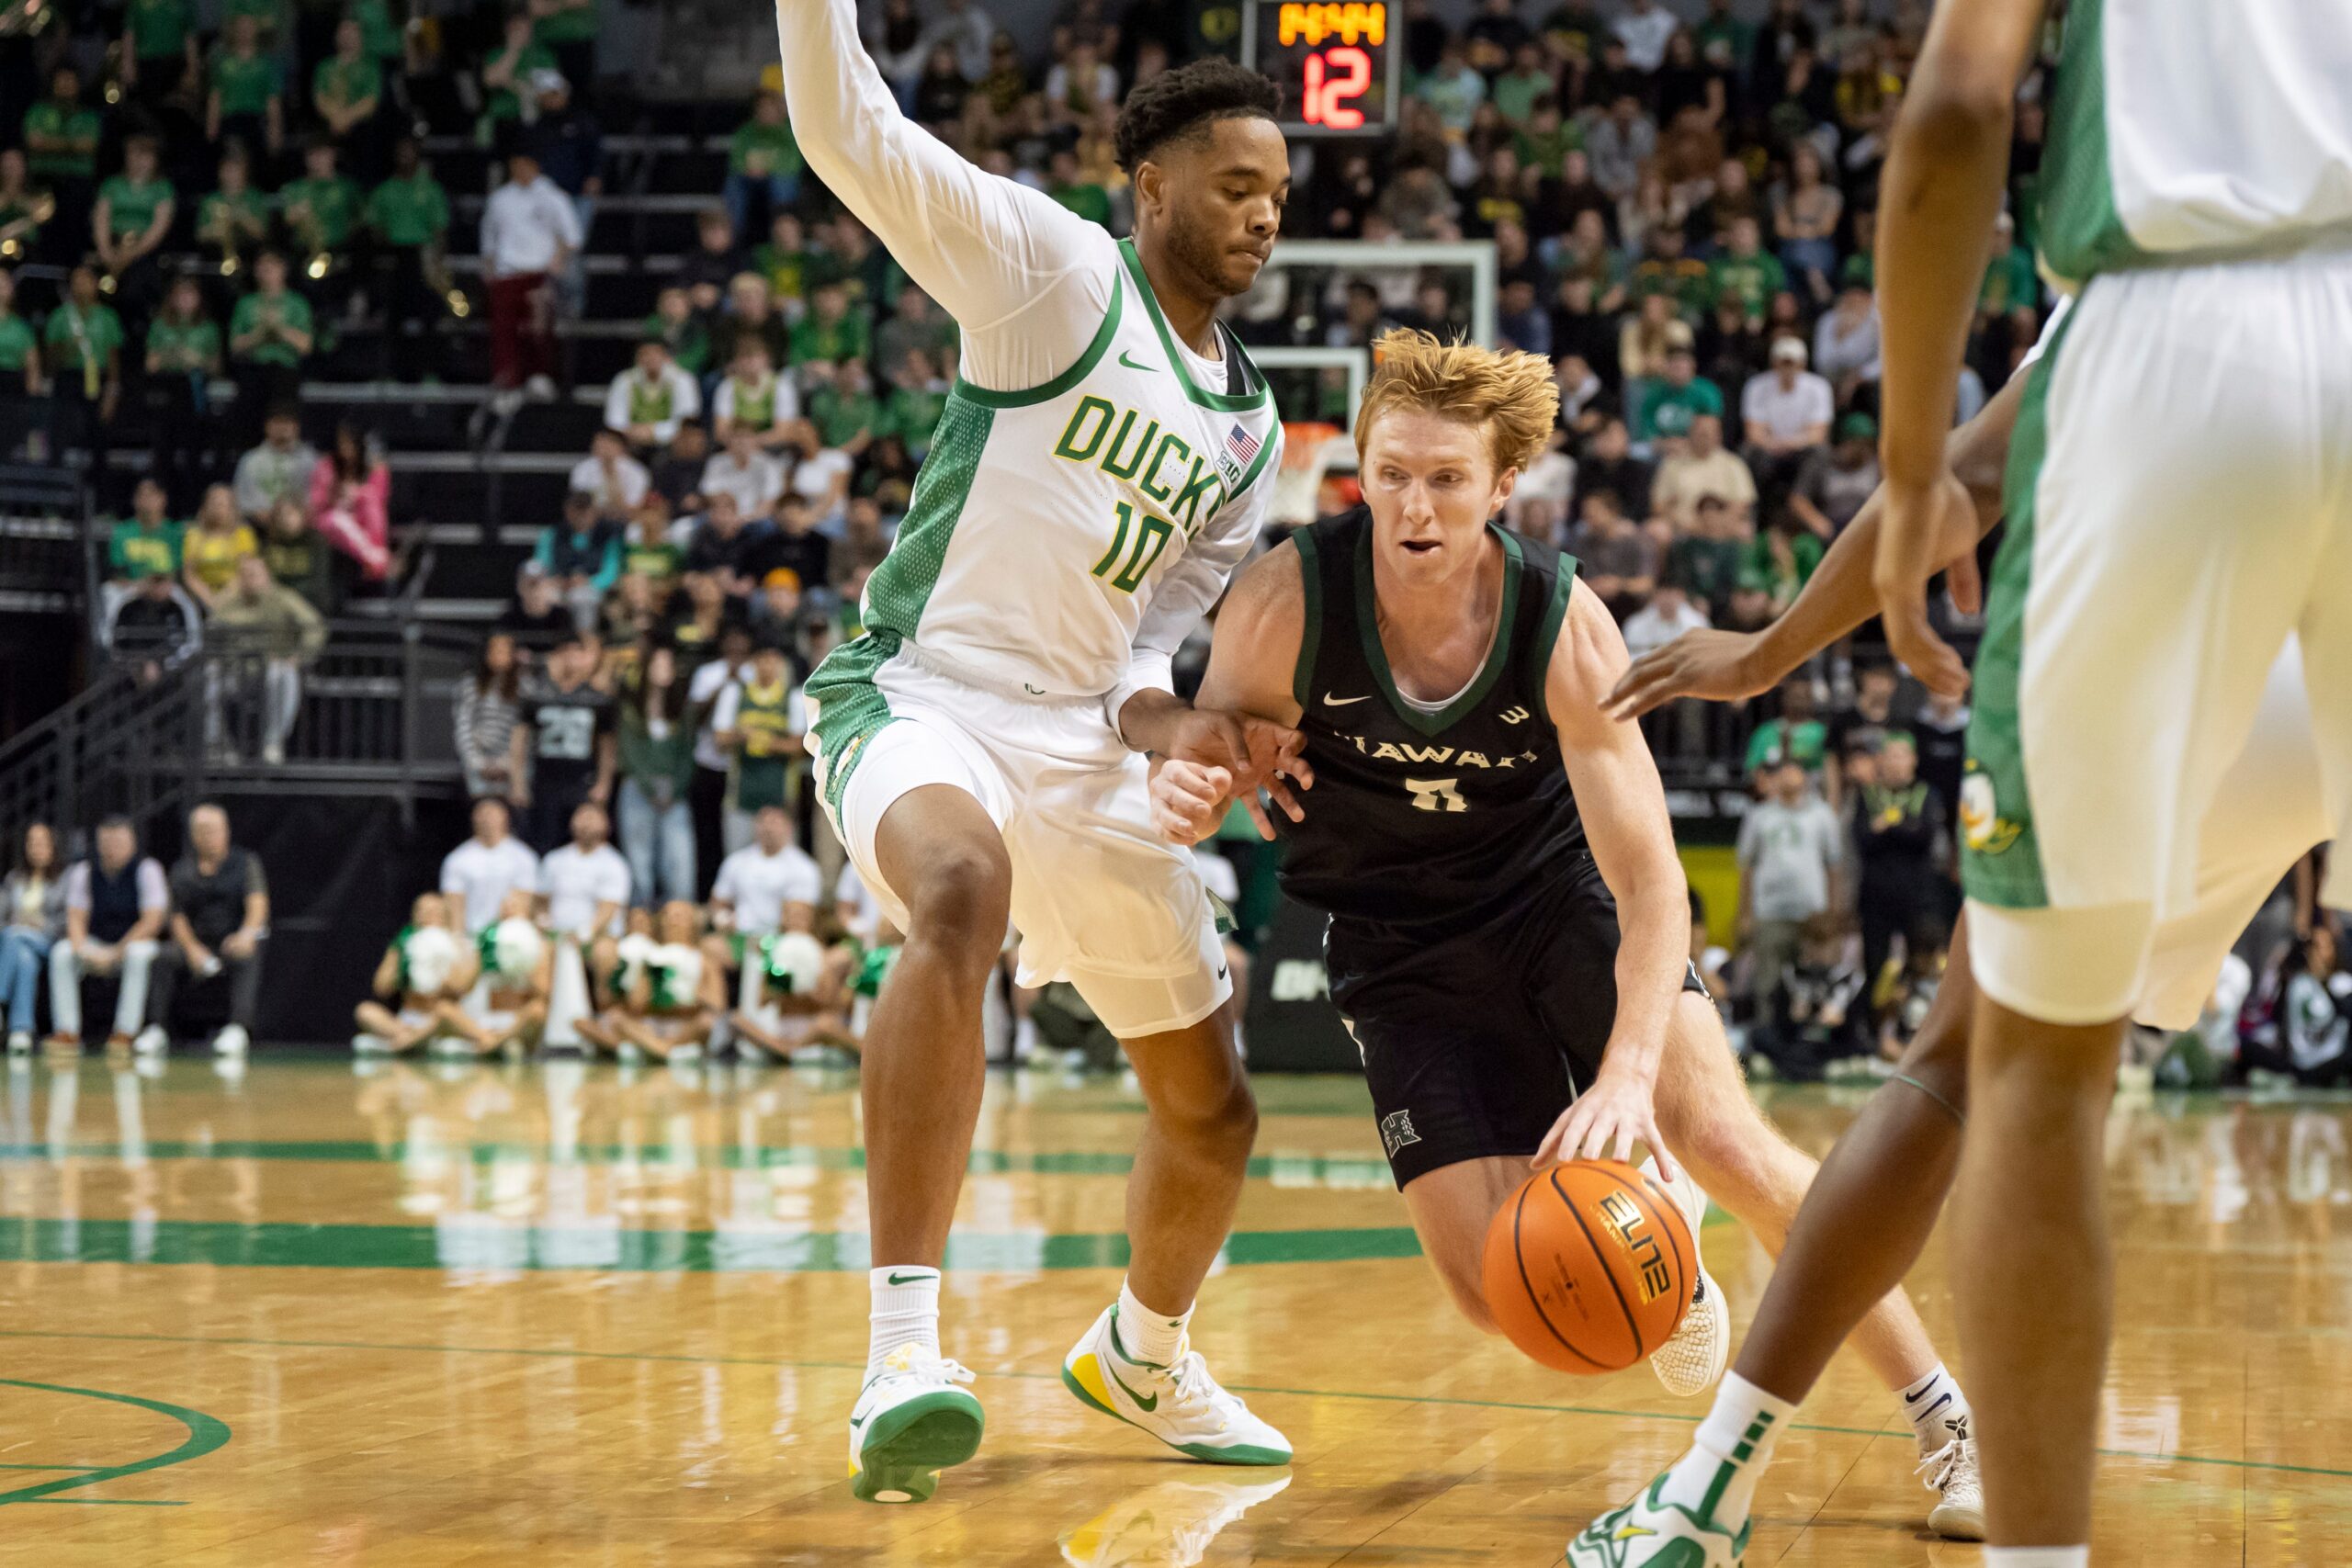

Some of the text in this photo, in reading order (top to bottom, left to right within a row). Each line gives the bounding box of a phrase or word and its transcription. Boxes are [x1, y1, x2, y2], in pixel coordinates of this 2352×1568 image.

[1302, 47, 1372, 130] 12
[1089, 499, 1175, 595] 10
[1599, 1190, 1672, 1300] ELITE
